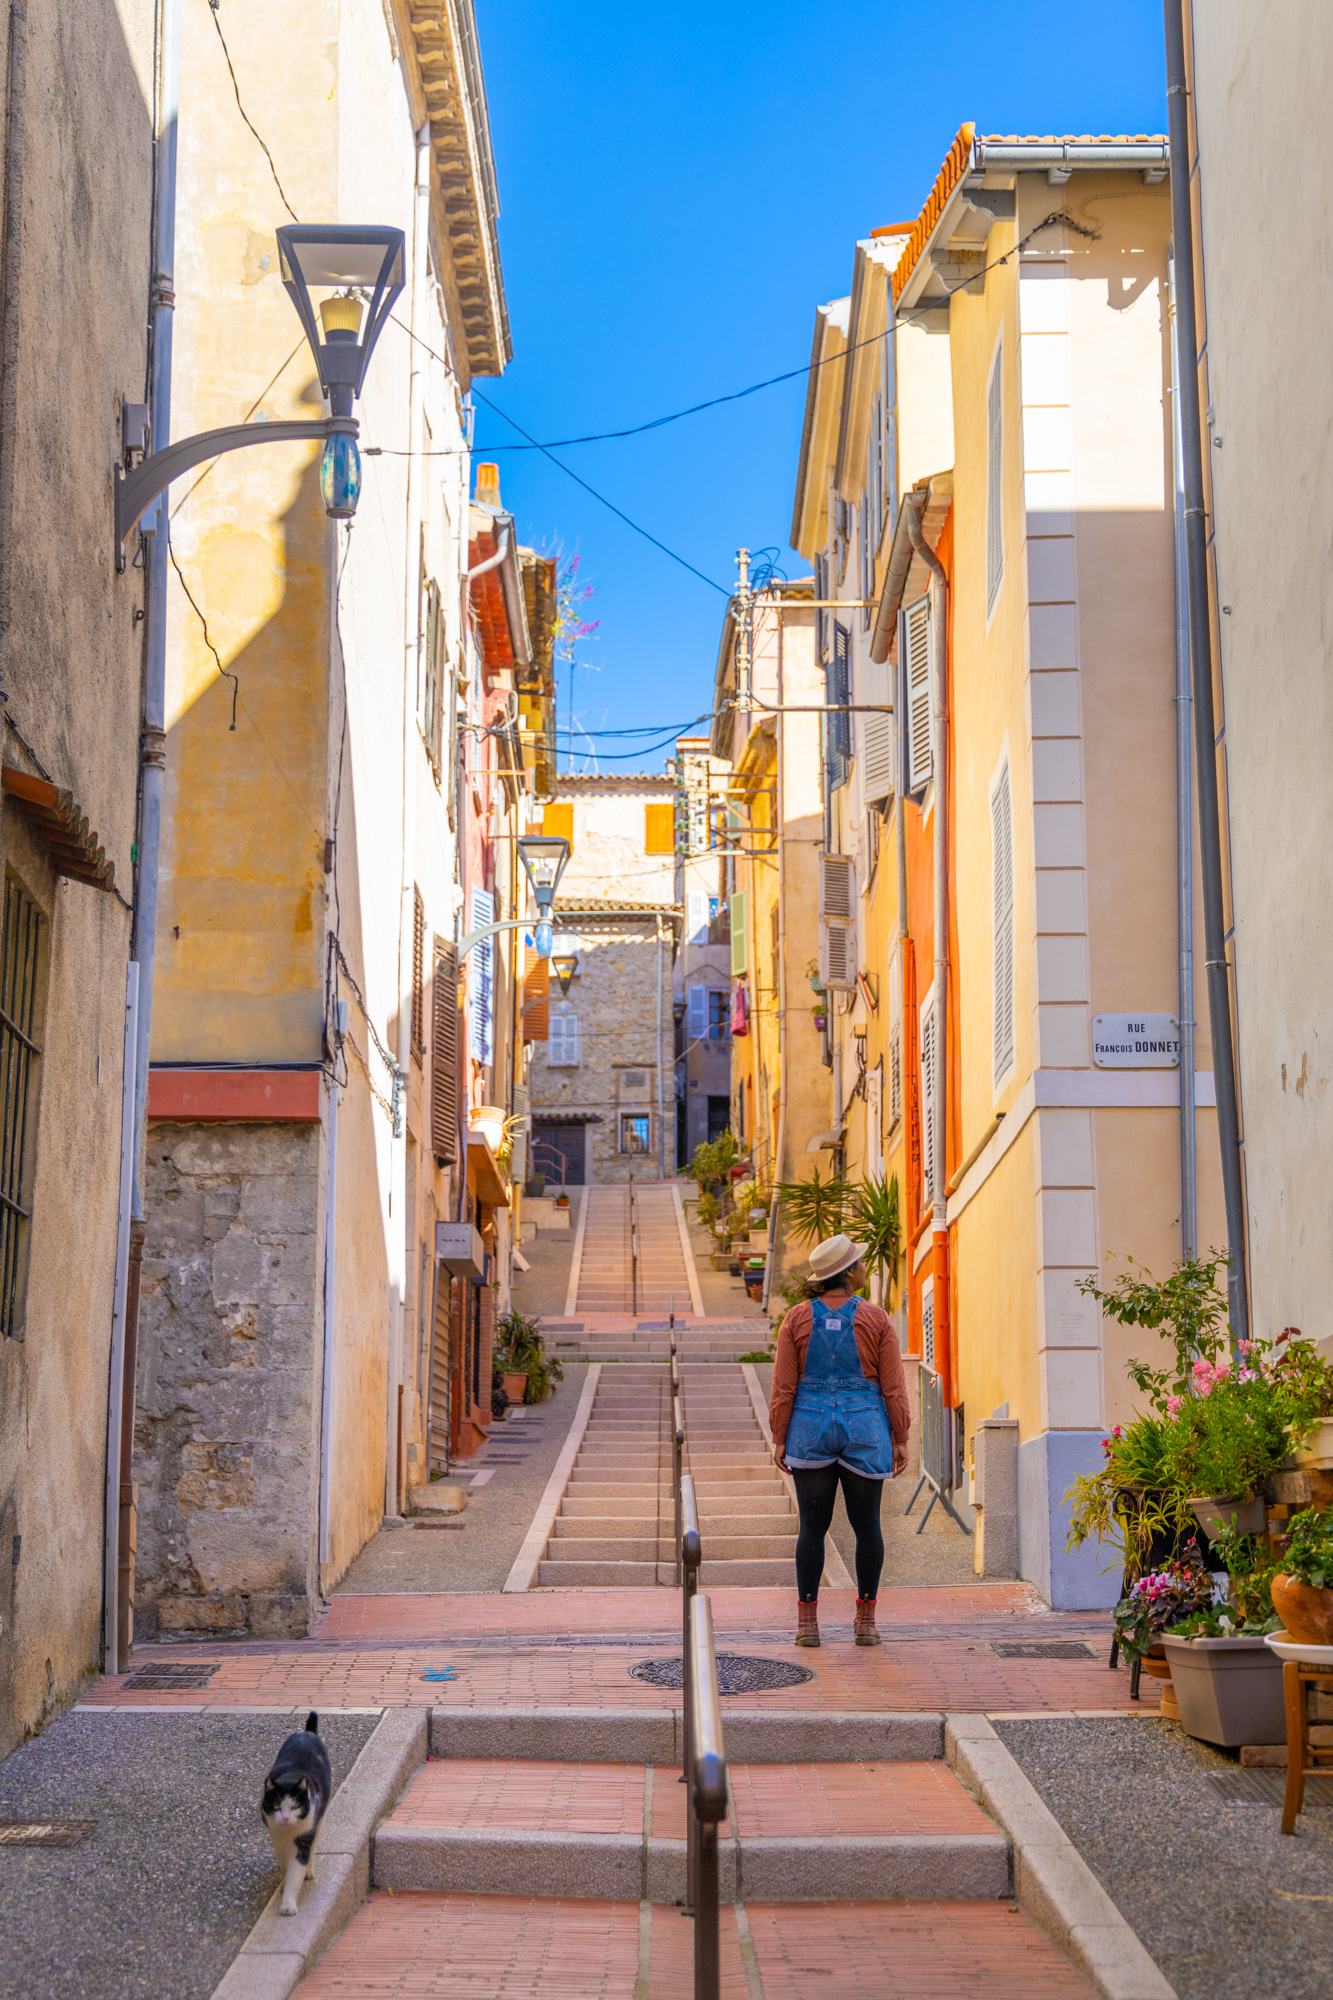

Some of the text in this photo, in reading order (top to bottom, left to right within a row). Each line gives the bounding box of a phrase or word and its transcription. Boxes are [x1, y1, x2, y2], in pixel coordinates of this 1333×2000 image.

[1127, 1023, 1146, 1033] RUE
[1095, 1041, 1179, 1053] FRANÇOIS DONNET
